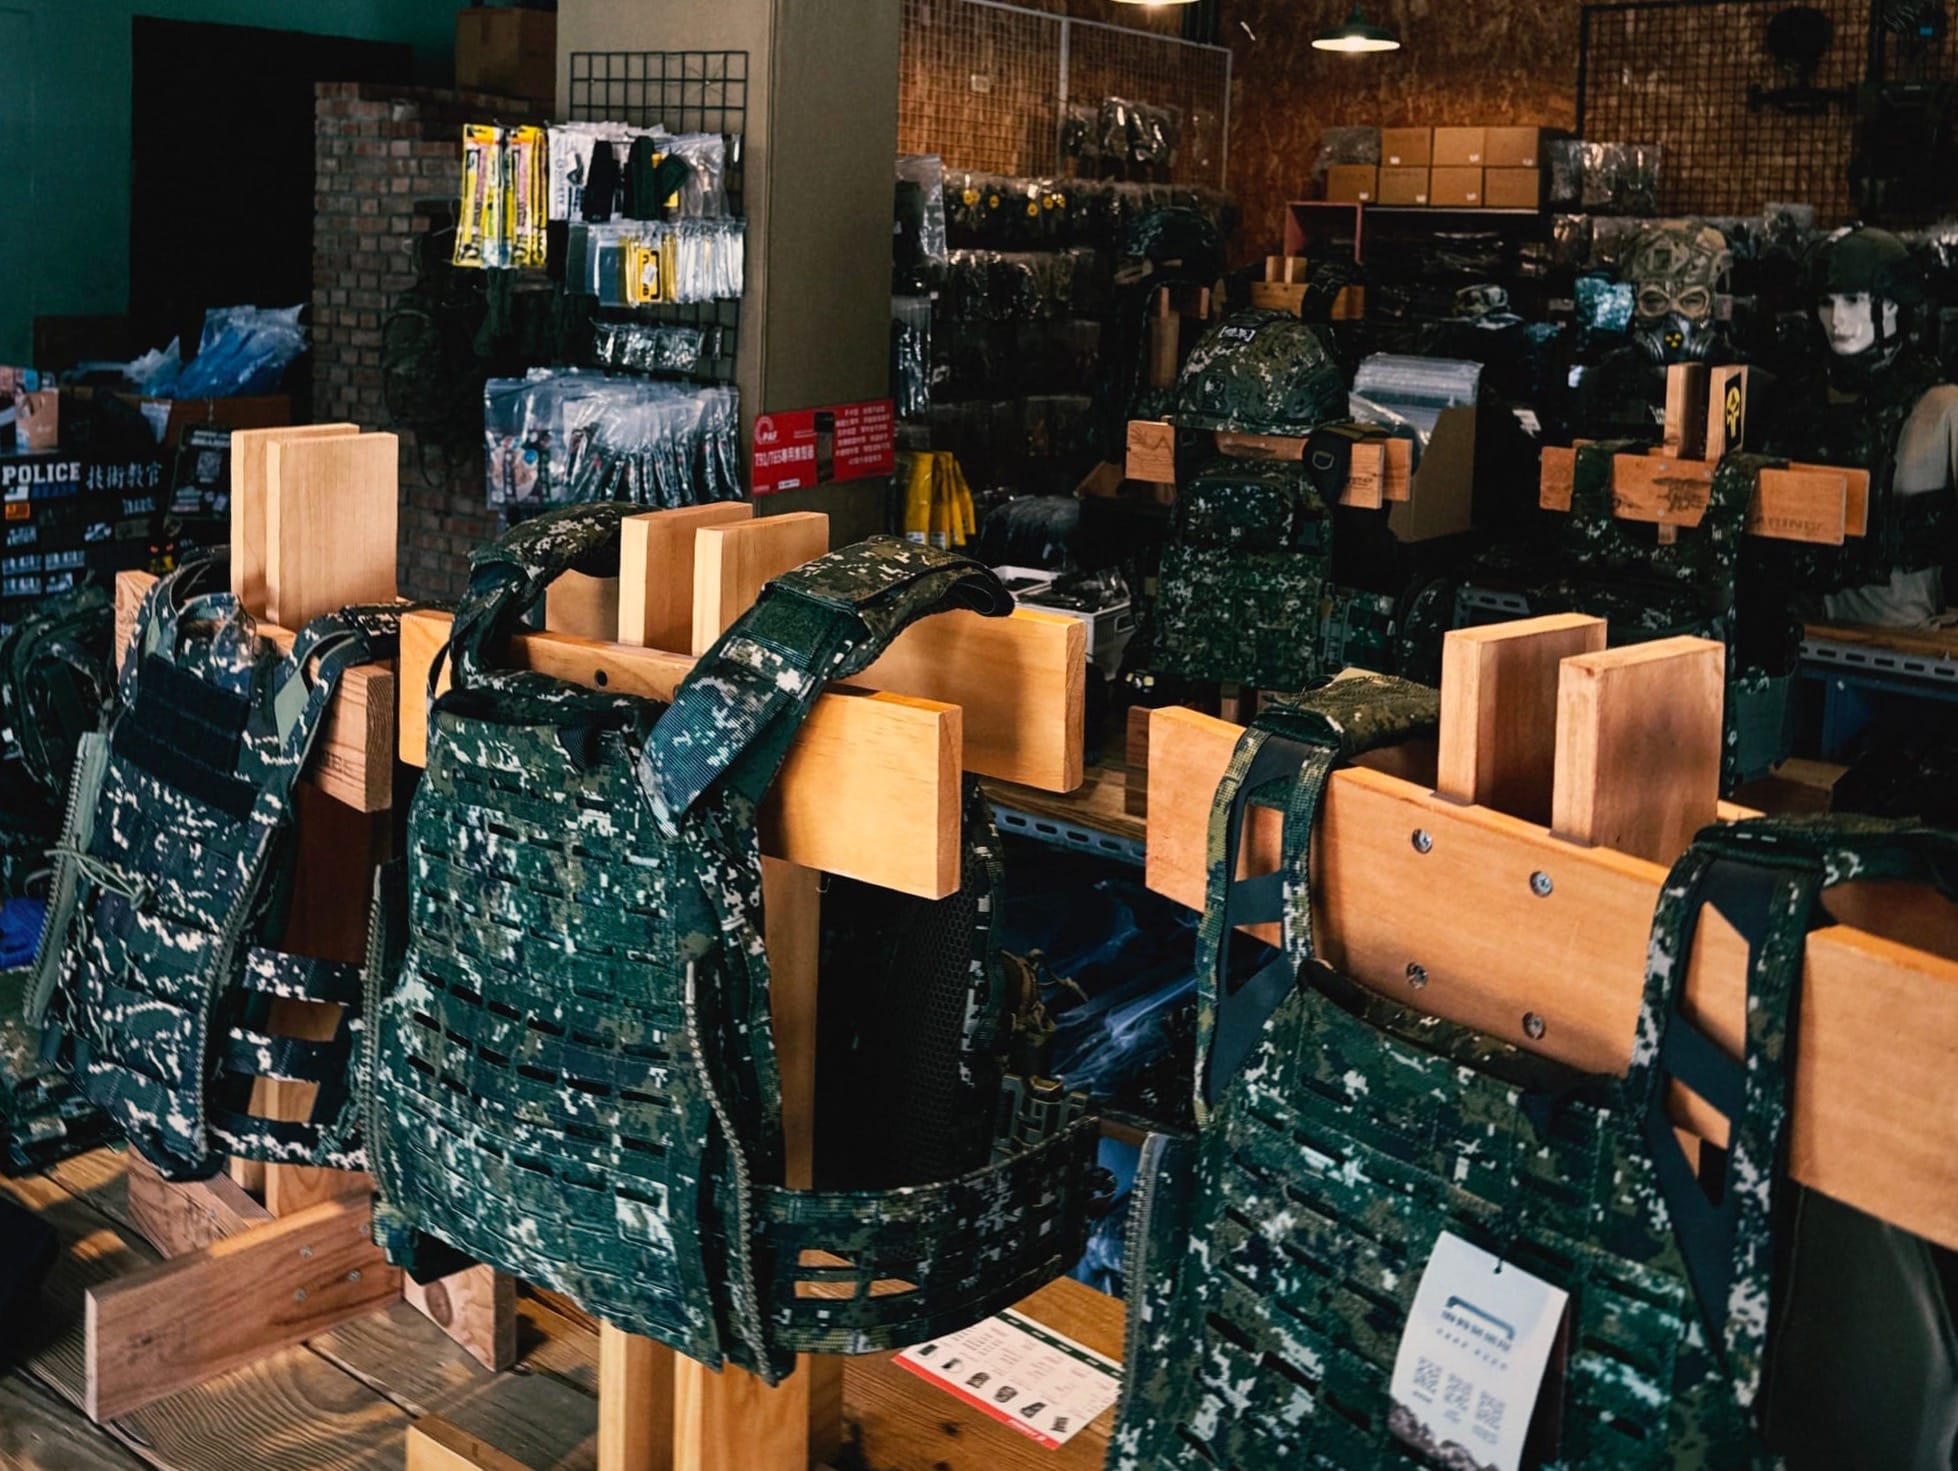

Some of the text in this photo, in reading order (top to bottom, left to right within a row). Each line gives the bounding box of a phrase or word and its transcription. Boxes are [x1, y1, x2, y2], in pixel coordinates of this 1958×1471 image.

[3, 462, 81, 485] POLICE
[86, 461, 163, 490] 技術教官
